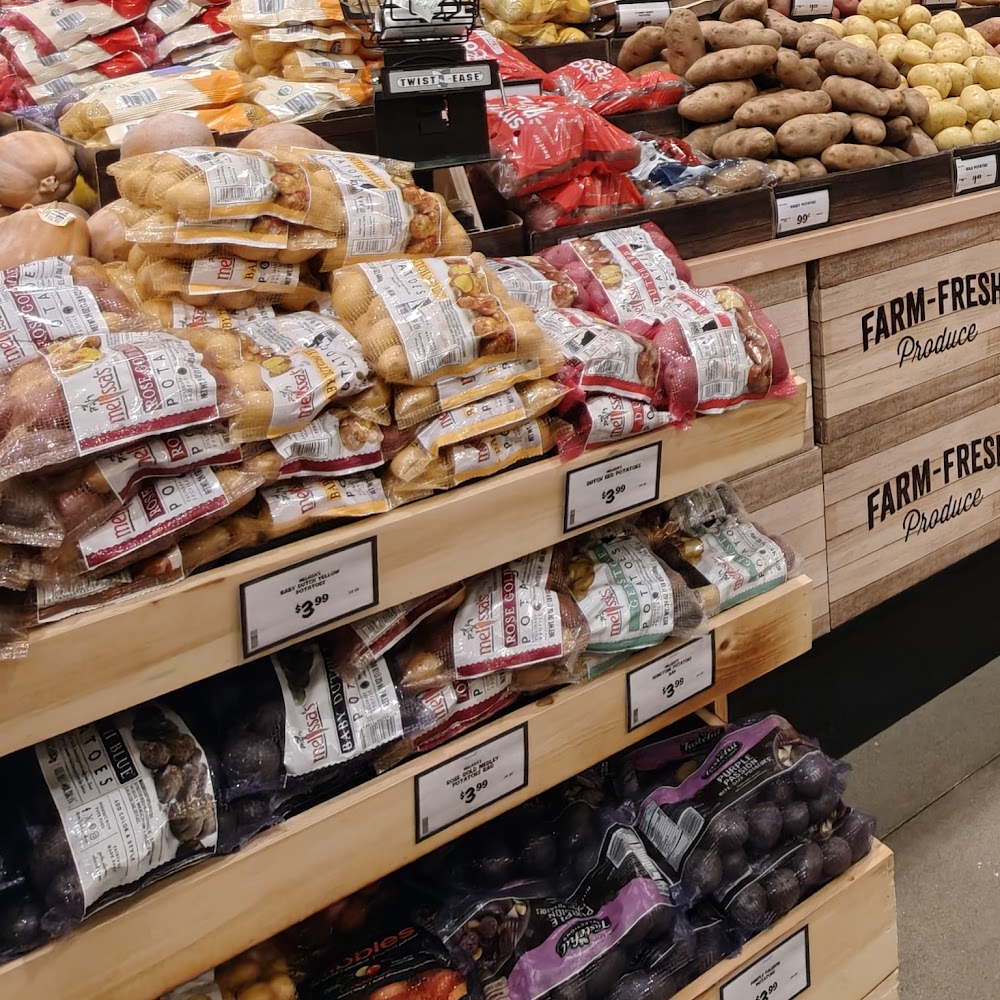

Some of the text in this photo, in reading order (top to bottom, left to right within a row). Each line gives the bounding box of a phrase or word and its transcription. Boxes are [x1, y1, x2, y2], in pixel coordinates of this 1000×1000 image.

[400, 76, 436, 87] TWIST
[896, 322, 979, 369] Produce
[615, 463, 642, 476] POTATOES
[902, 487, 985, 543] Produce
[295, 580, 326, 595] POTATOES
[317, 568, 341, 581] YELLOW
[503, 569, 519, 647] ROSE GOLD
[339, 710, 354, 753] BABY
[109, 741, 136, 782] BLUE
[716, 753, 754, 784] PURPLE
[723, 758, 758, 786] PASSION
[118, 812, 129, 833] COLOR
[127, 838, 136, 862] STYLE
[560, 919, 611, 957] Tasteful
